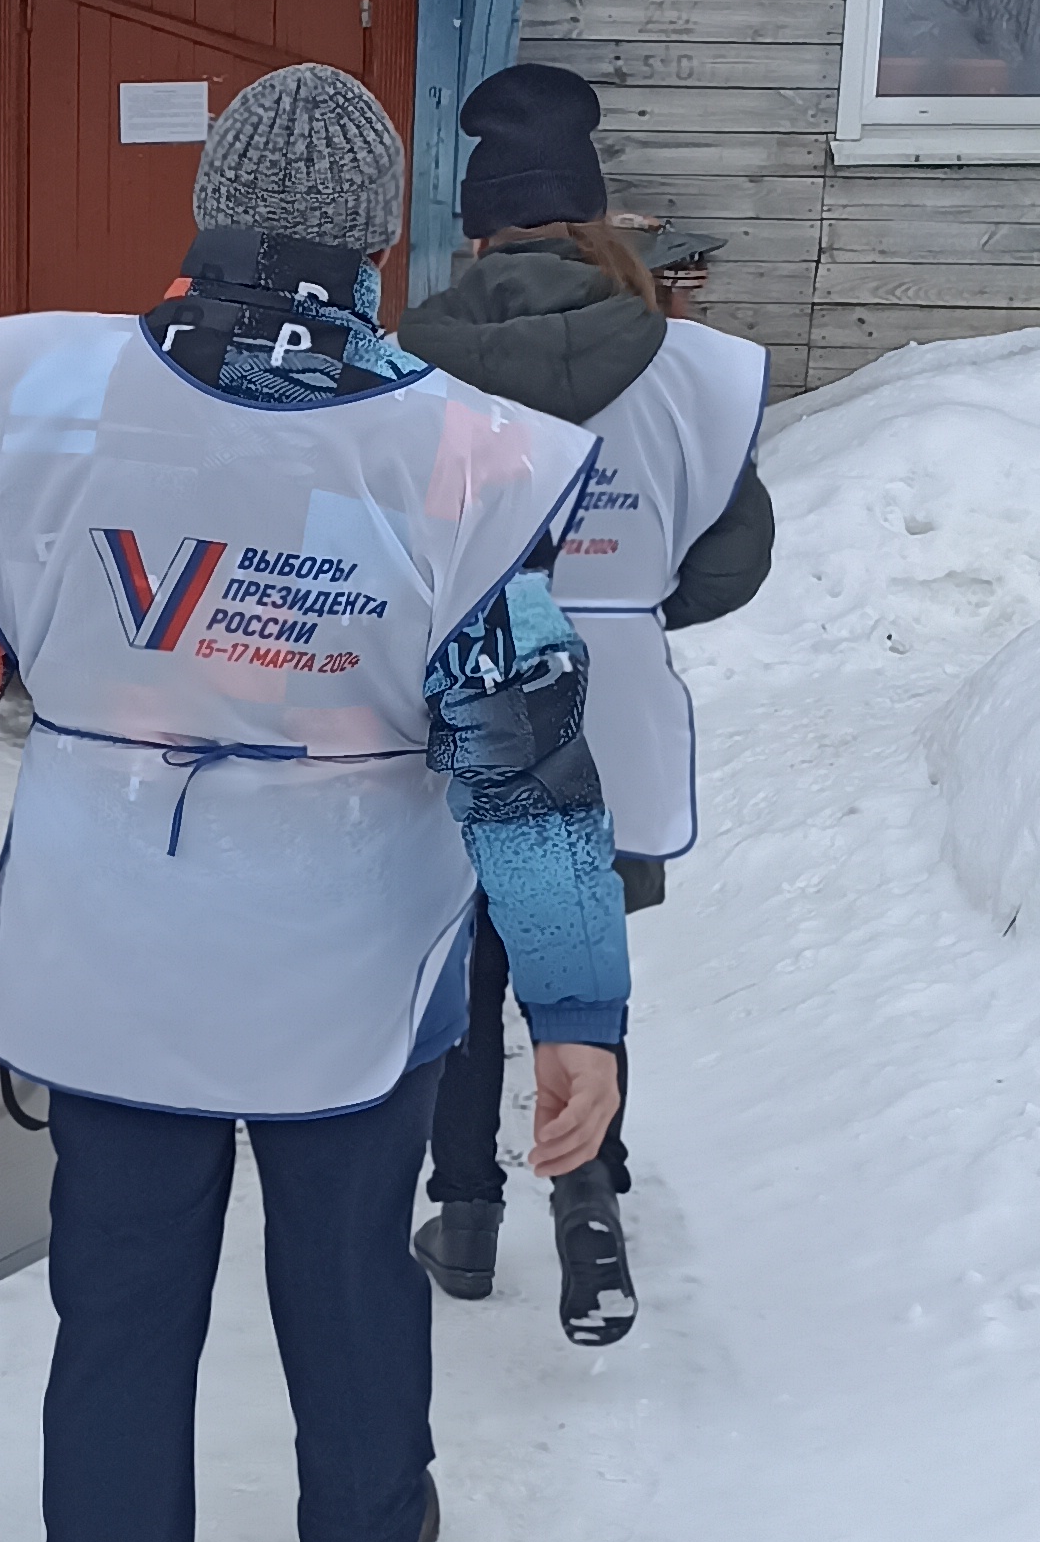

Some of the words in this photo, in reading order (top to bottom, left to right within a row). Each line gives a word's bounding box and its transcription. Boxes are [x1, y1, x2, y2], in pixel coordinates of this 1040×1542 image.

[579, 491, 639, 511] ДЕНТА
[237, 547, 358, 583] ВЫБОРЫ
[221, 578, 389, 618] ПРЕЗИДЕНТА
[205, 608, 319, 645] РОССИИ
[248, 646, 315, 672] МАРТА
[317, 651, 362, 674] 2024
